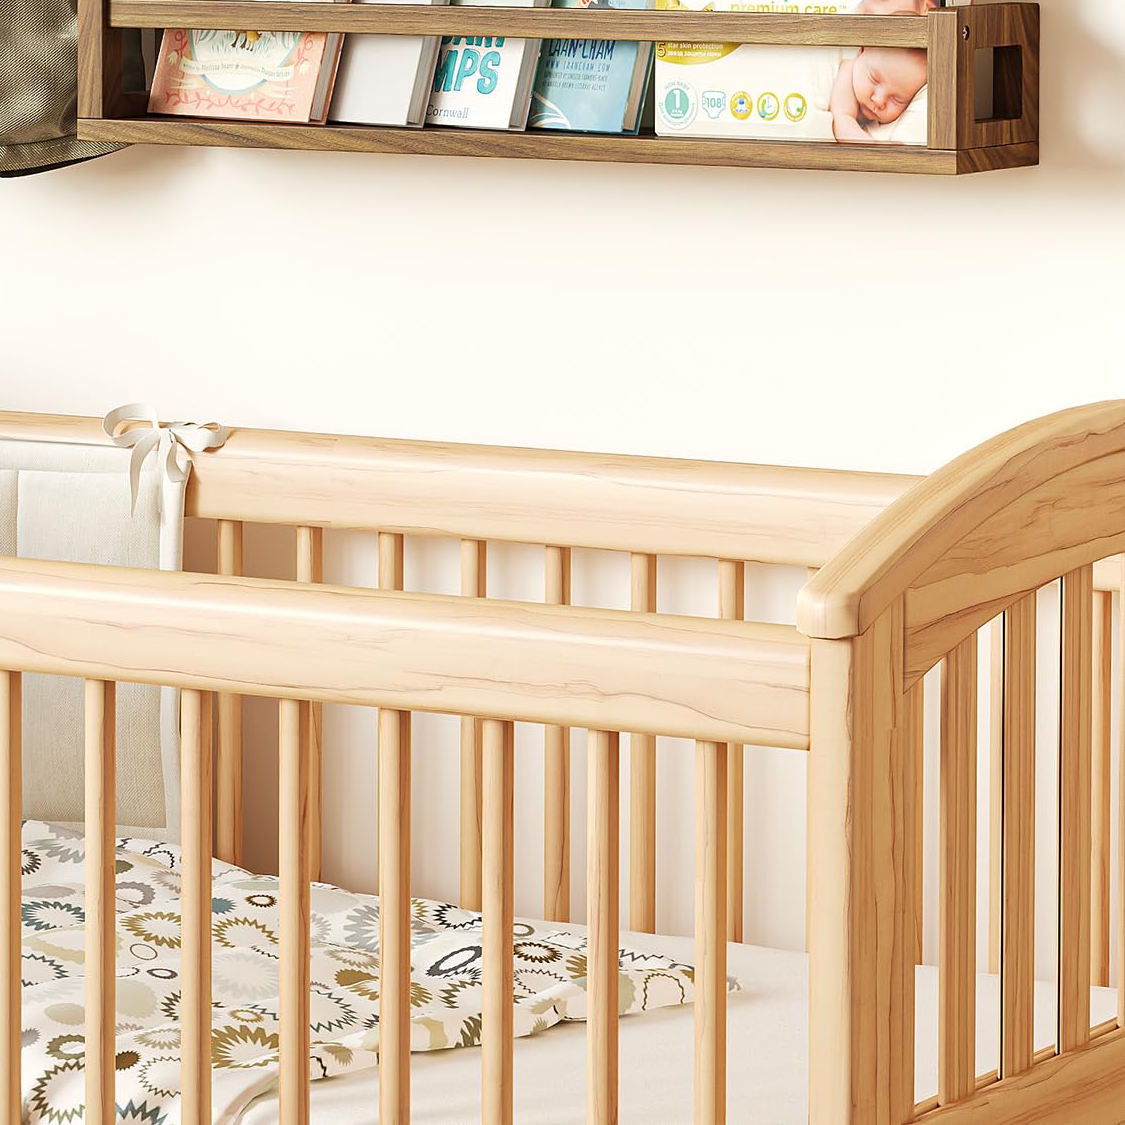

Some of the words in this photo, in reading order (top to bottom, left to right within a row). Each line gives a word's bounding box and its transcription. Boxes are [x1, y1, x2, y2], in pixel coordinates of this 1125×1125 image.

[657, 42, 666, 57] 5
[673, 89, 681, 109] 1
[705, 97, 722, 108] 108
[426, 105, 469, 119] Cornwall
